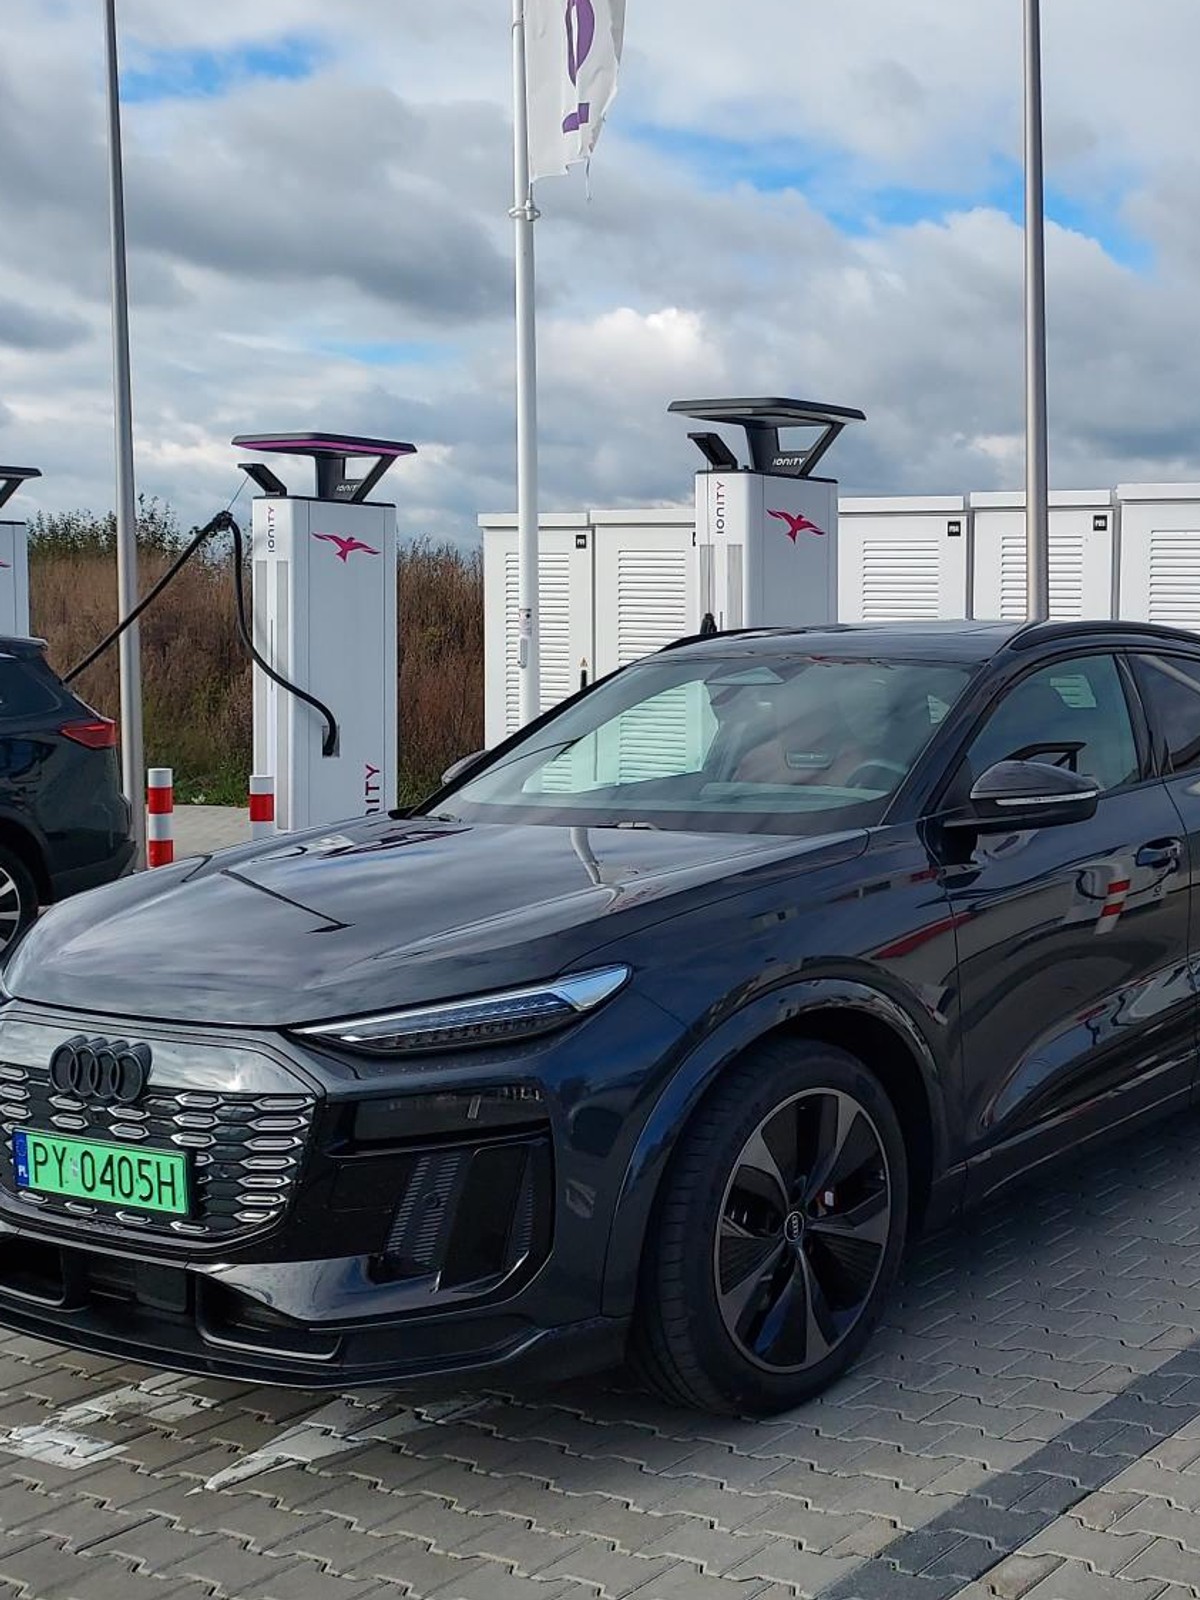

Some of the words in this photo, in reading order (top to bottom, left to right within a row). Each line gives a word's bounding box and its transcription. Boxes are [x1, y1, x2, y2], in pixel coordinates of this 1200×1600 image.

[773, 457, 806, 466] IONITY
[267, 506, 275, 553] IONITY
[716, 481, 725, 534] IONITY
[18, 1164, 29, 1178] PL
[32, 1141, 67, 1188] PY
[80, 1149, 177, 1207] 0405H
